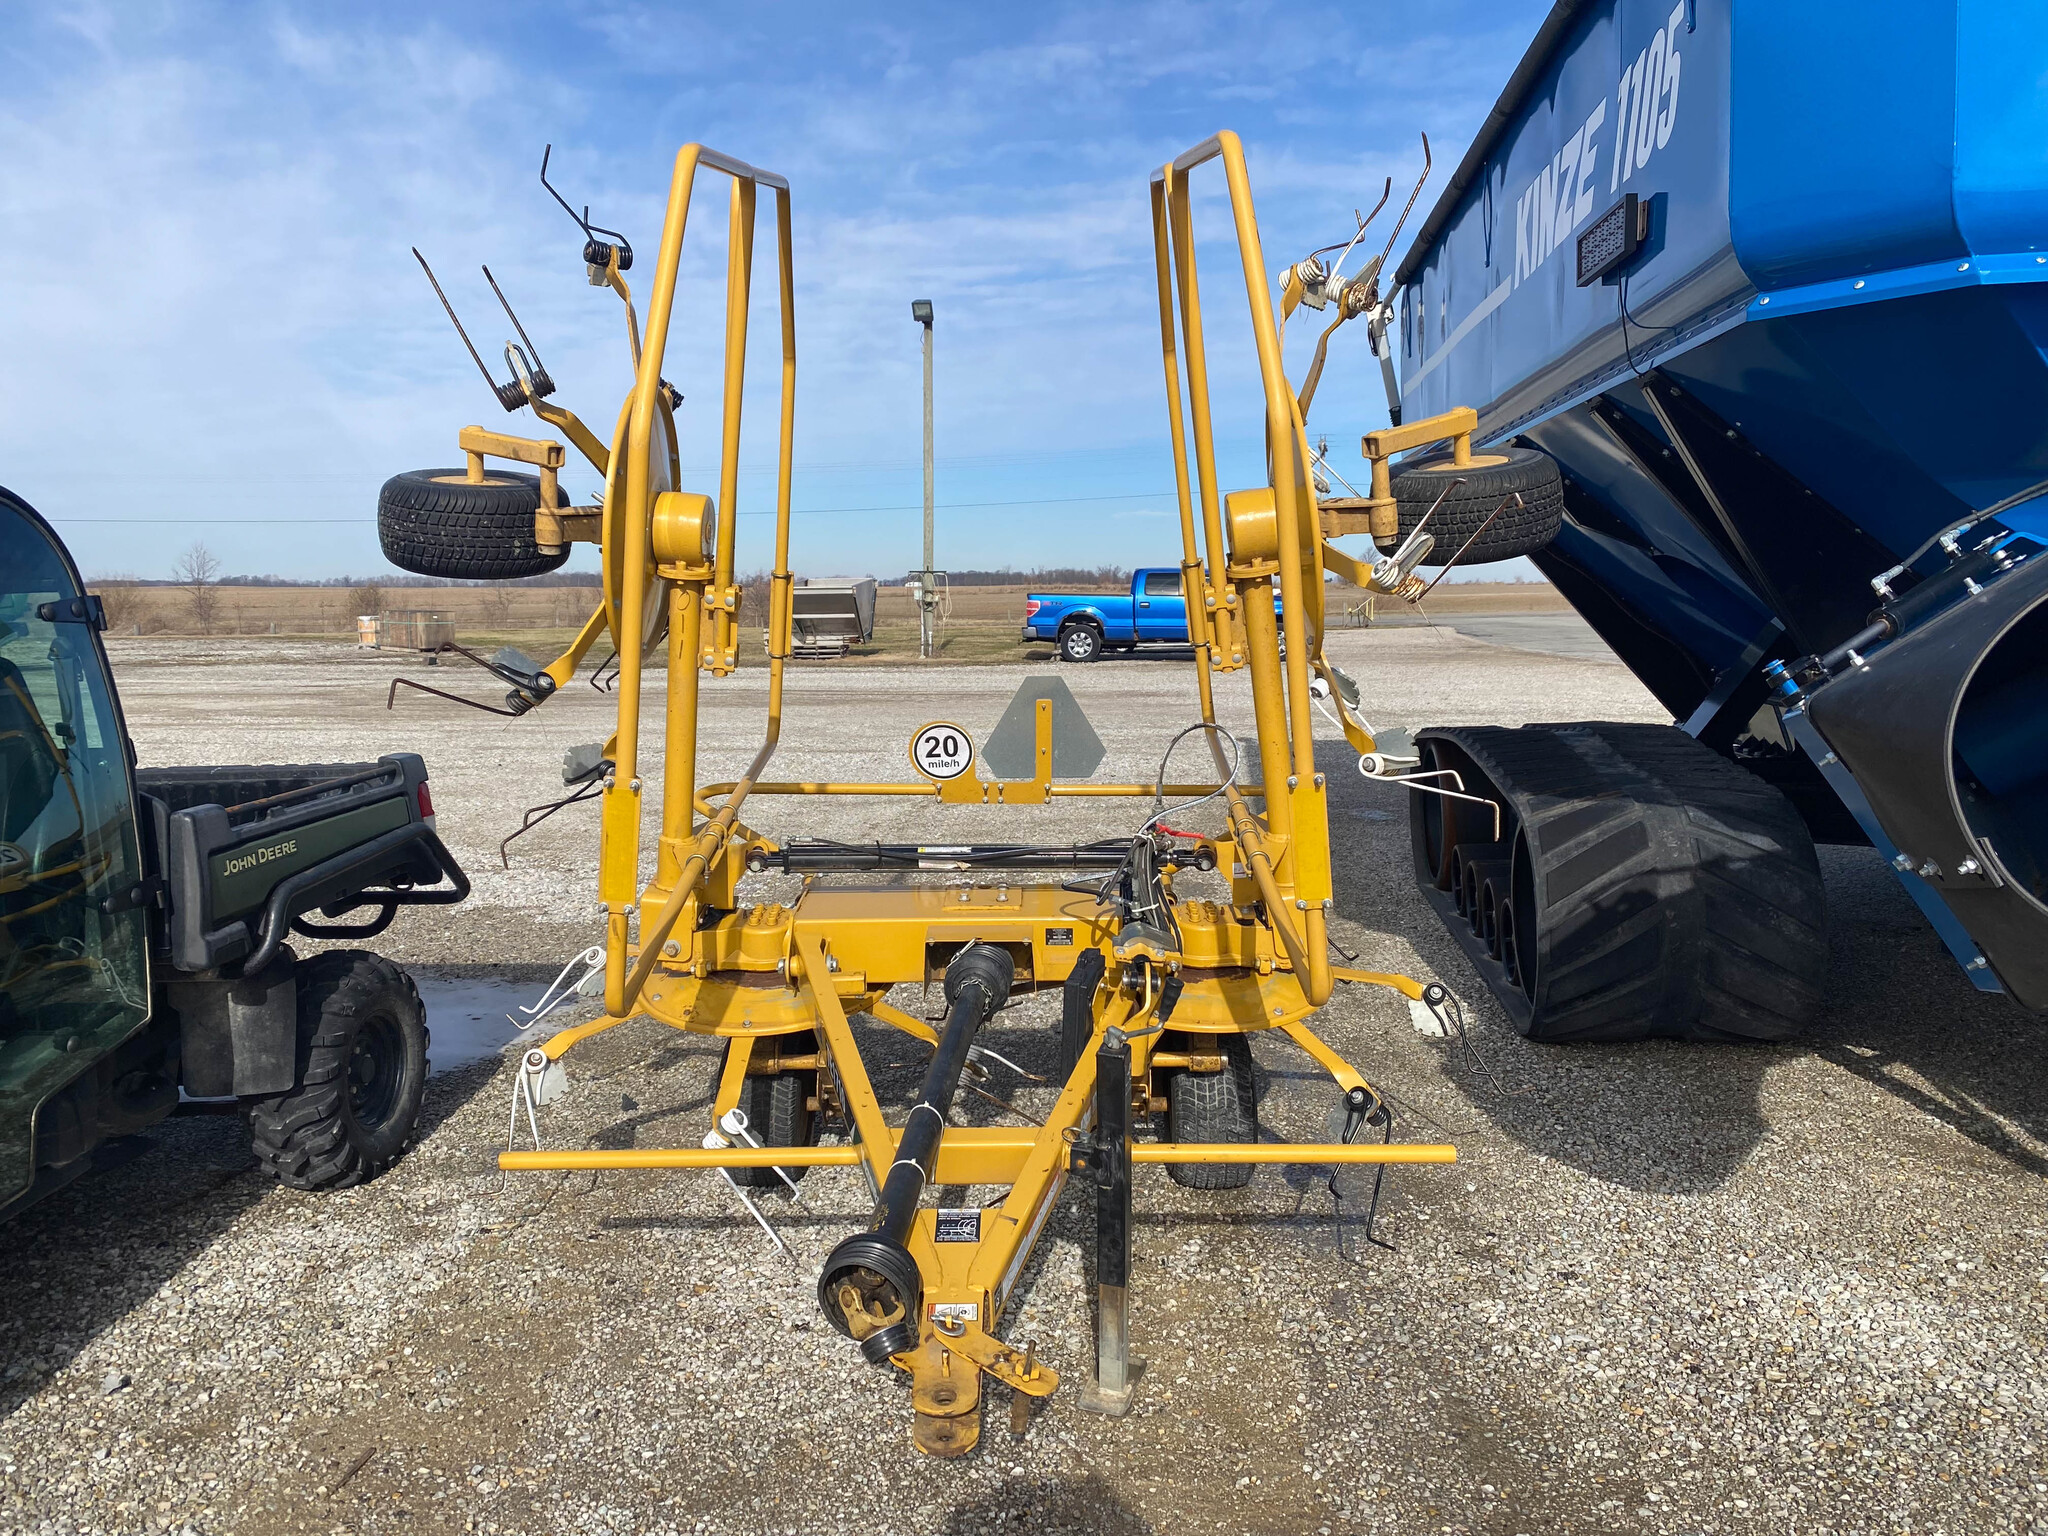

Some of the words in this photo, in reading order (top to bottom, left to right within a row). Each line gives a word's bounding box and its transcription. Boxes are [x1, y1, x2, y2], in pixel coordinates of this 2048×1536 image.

[1514, 97, 1606, 290] KINZE
[1610, 0, 1684, 194] 1105
[925, 735, 958, 758] 20
[928, 759, 960, 768] mile/h
[224, 854, 256, 876] JOHN
[257, 840, 297, 863] DEERE
